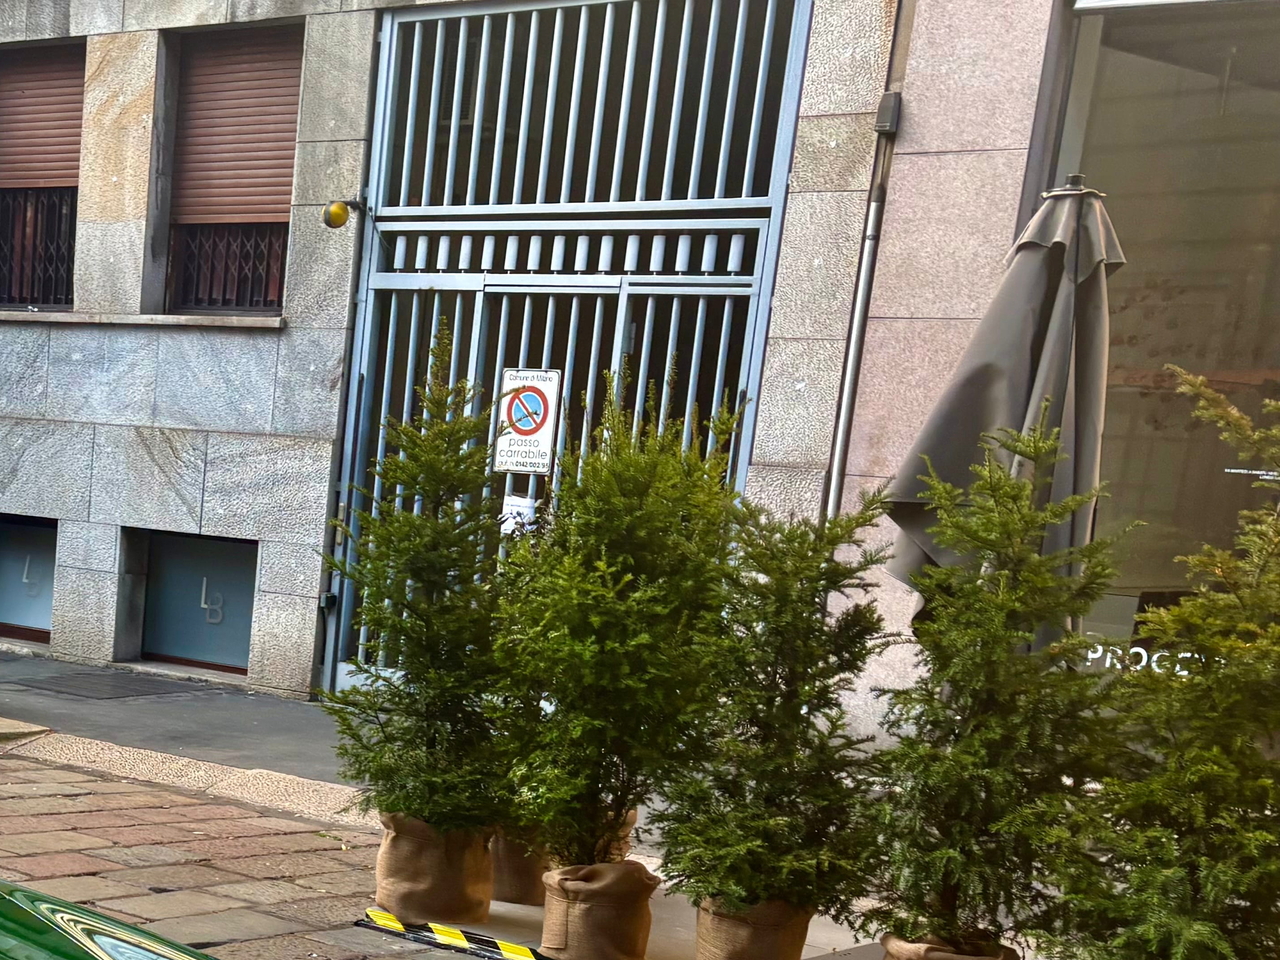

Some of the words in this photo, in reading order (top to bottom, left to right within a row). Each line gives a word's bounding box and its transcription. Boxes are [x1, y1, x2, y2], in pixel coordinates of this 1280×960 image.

[509, 374, 529, 382] Comune
[536, 374, 553, 382] Milano
[508, 438, 540, 448] passo
[499, 449, 548, 460] carrabile
